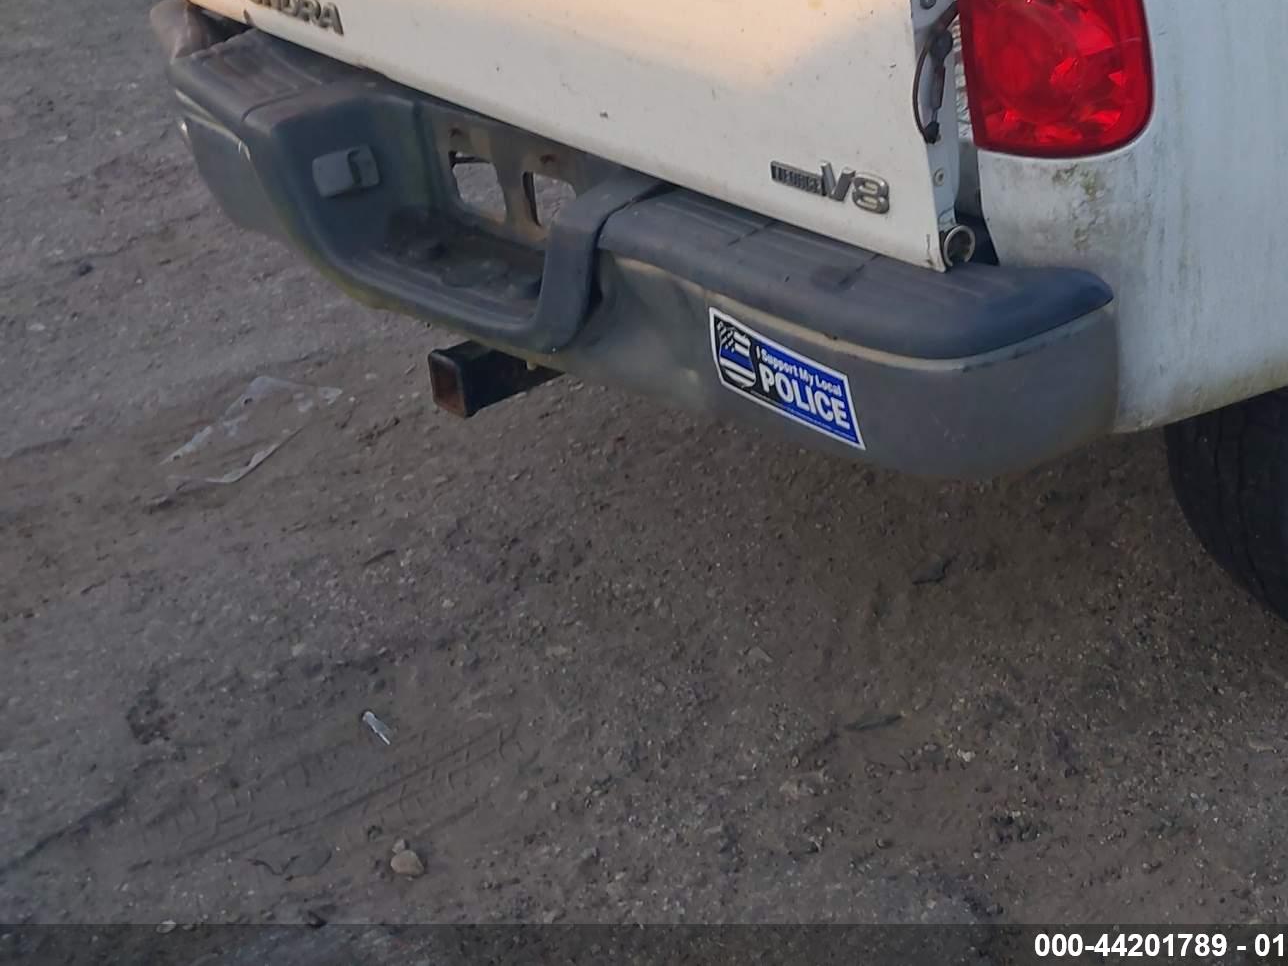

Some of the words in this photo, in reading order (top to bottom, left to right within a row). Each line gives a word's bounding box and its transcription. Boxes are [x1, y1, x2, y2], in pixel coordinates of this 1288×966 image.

[820, 162, 890, 214] V8
[758, 362, 851, 431] POLICE
[761, 348, 799, 378] Support
[799, 366, 815, 386] My
[815, 374, 843, 398] Local
